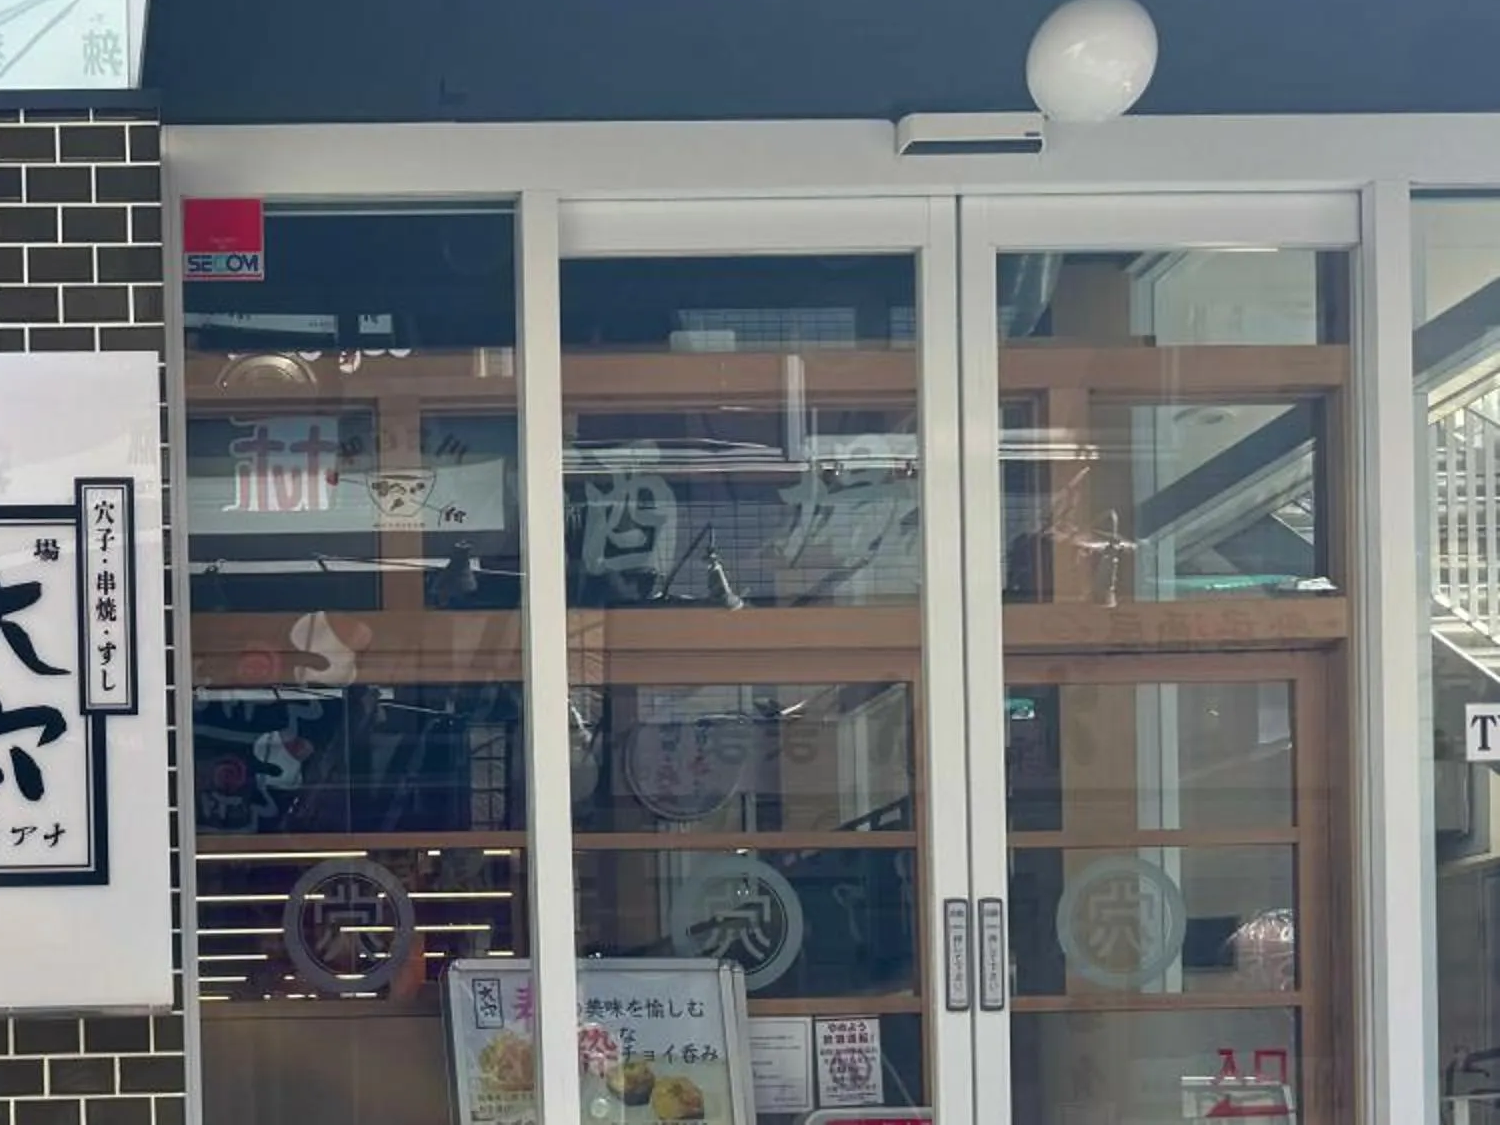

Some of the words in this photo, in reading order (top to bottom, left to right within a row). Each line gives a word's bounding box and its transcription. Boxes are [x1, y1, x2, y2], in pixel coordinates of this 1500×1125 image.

[187, 254, 259, 273] SECOM
[94, 500, 117, 692] 穴子・串焼・すし
[1470, 714, 1500, 752] T
